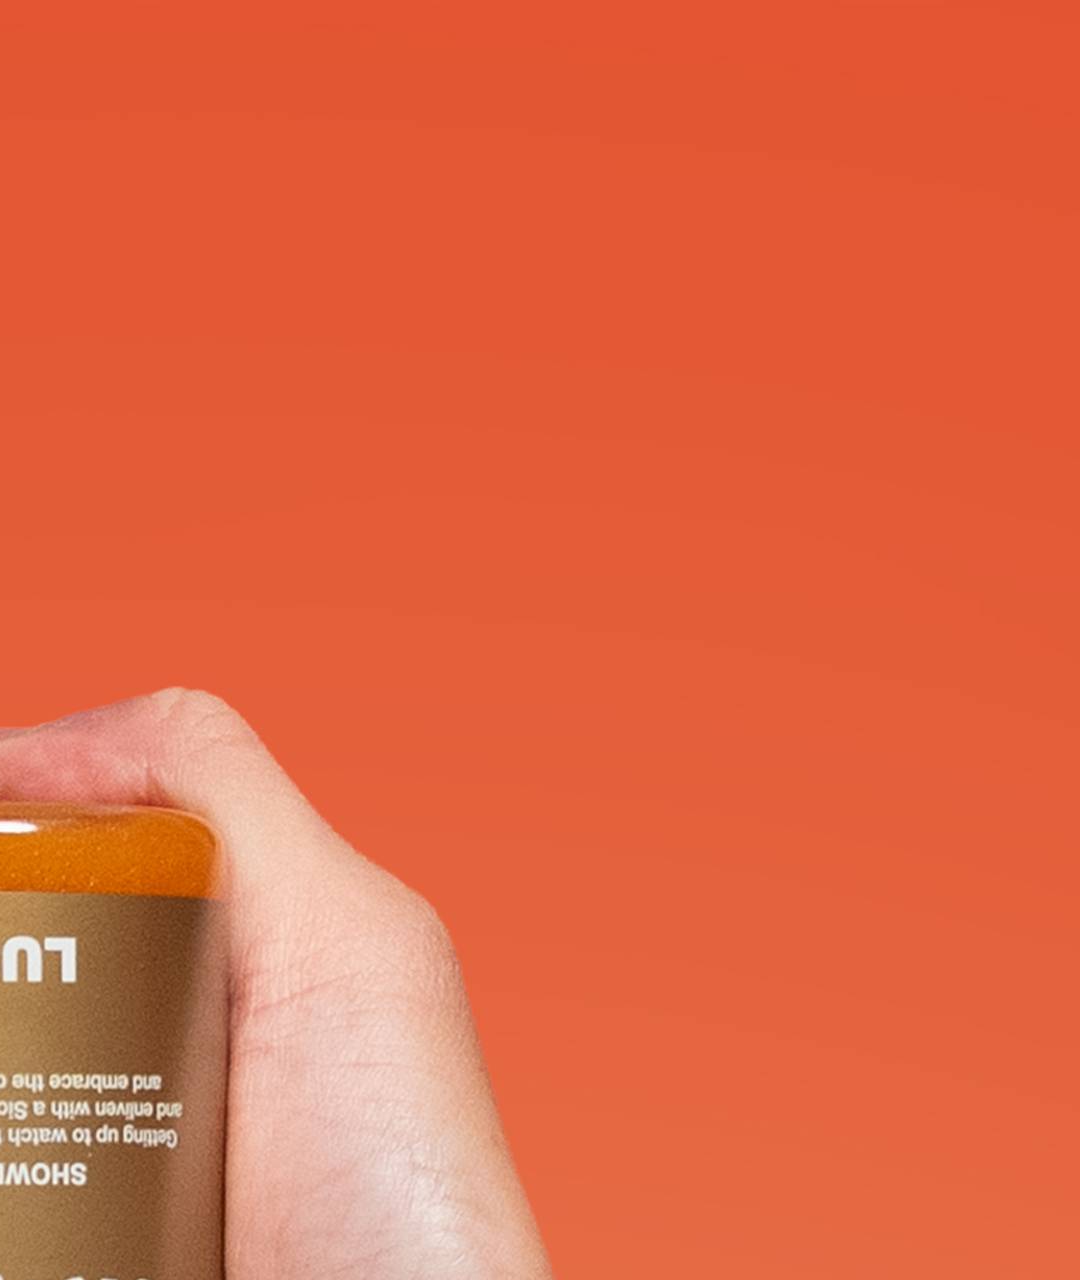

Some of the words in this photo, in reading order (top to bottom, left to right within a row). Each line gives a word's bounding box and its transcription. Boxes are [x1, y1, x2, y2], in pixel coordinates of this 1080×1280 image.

[11, 1073, 45, 1093] the
[48, 1073, 129, 1094] embrace
[132, 1074, 162, 1094] and
[32, 1100, 46, 1116] a
[50, 1101, 91, 1121] with
[94, 1100, 154, 1121] enliven
[156, 1102, 183, 1121] and
[8, 1127, 68, 1147] watch
[71, 1127, 93, 1147] to
[95, 1124, 120, 1144] up
[122, 1124, 178, 1149] Getting
